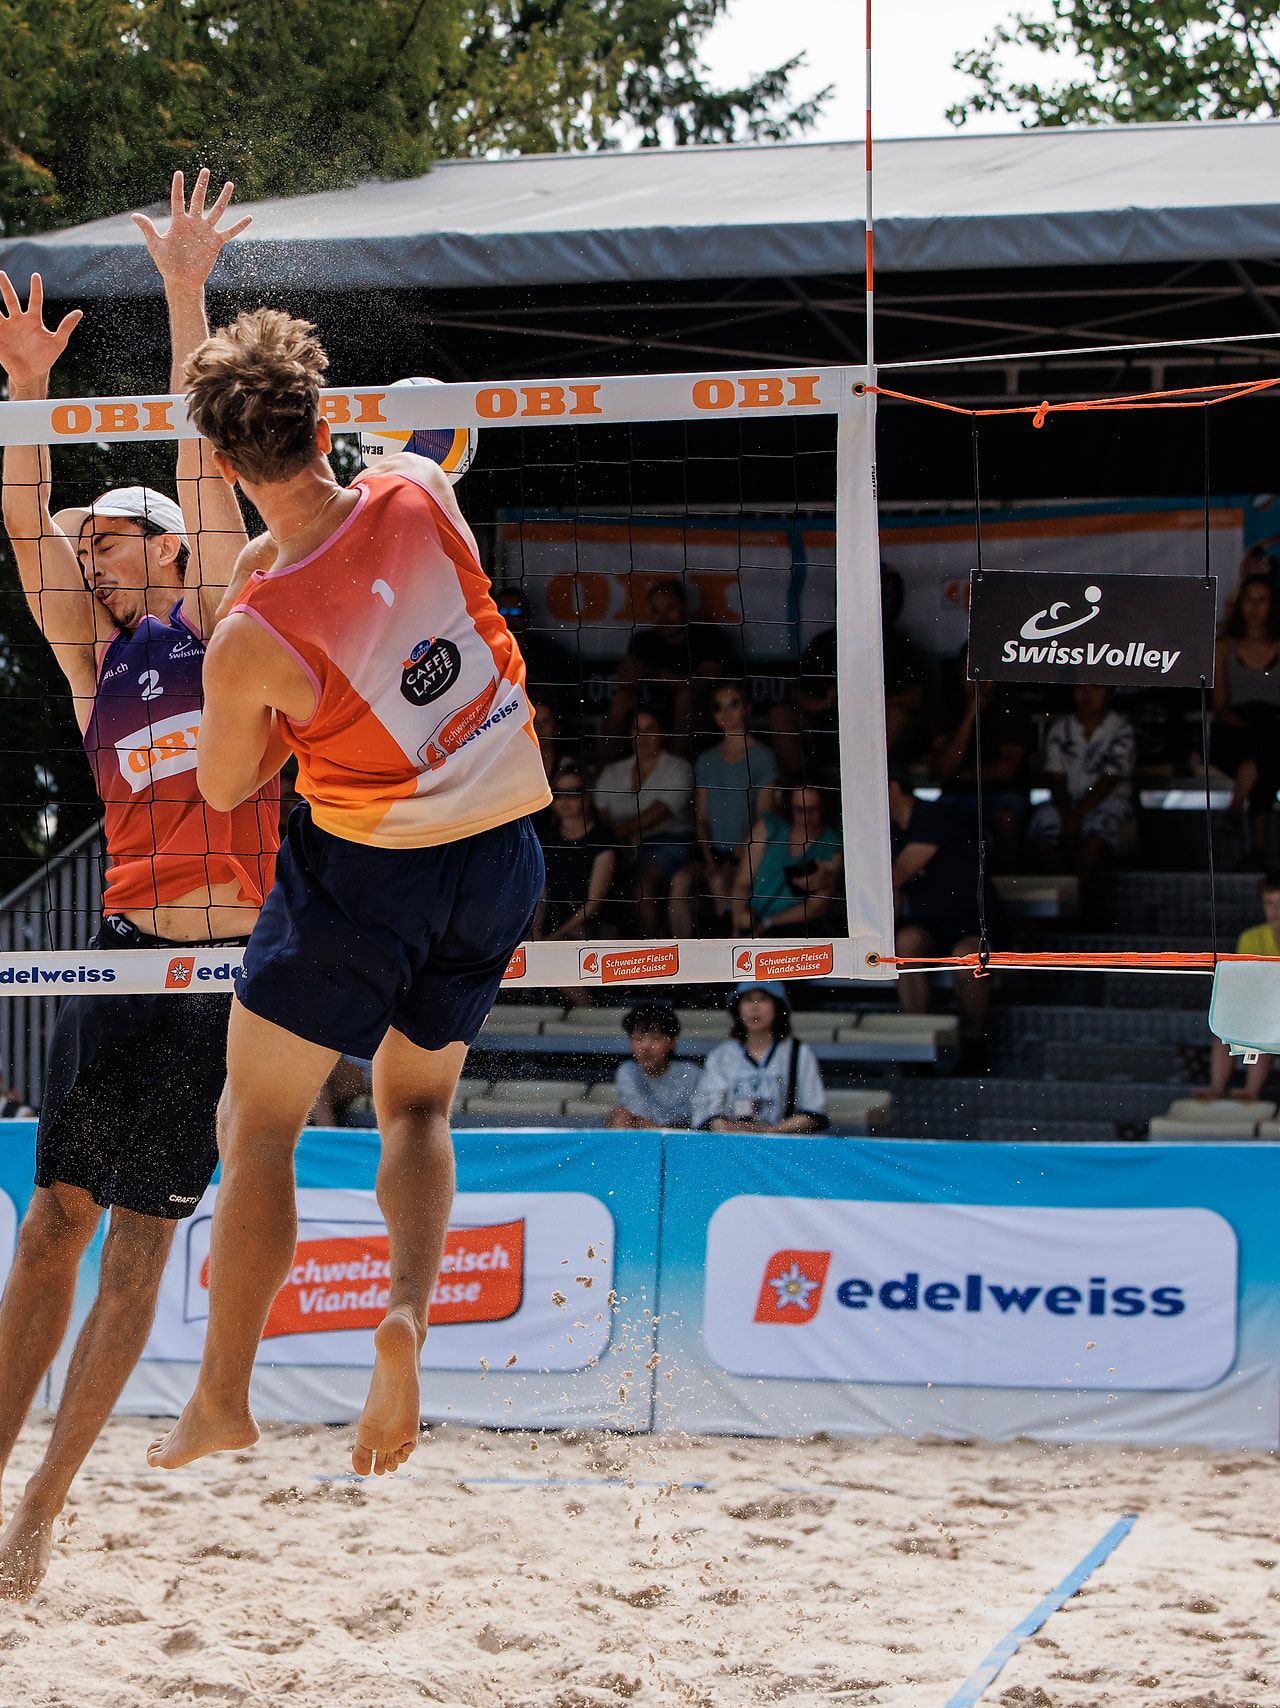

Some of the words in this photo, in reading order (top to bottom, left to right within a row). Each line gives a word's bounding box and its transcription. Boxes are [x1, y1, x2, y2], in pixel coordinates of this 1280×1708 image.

[320, 393, 387, 425] BI
[475, 385, 603, 419] OBI
[692, 376, 821, 411] OBI
[51, 401, 175, 435] OBI
[406, 647, 449, 685] CAFFÈ
[1000, 640, 1181, 673] SwissVolley
[138, 669, 164, 701] 2
[413, 657, 454, 697] LATTE
[605, 957, 646, 968] Schweizer
[646, 952, 674, 963] Fleisch
[613, 965, 640, 976] Viande
[641, 963, 667, 973] Suisse
[759, 956, 801, 967] Schweizer
[800, 951, 829, 962] Fleisch
[766, 963, 795, 975] Viande
[794, 961, 821, 971] Suisse
[439, 1244, 510, 1273] eisch
[835, 1273, 1186, 1317] edelweiss
